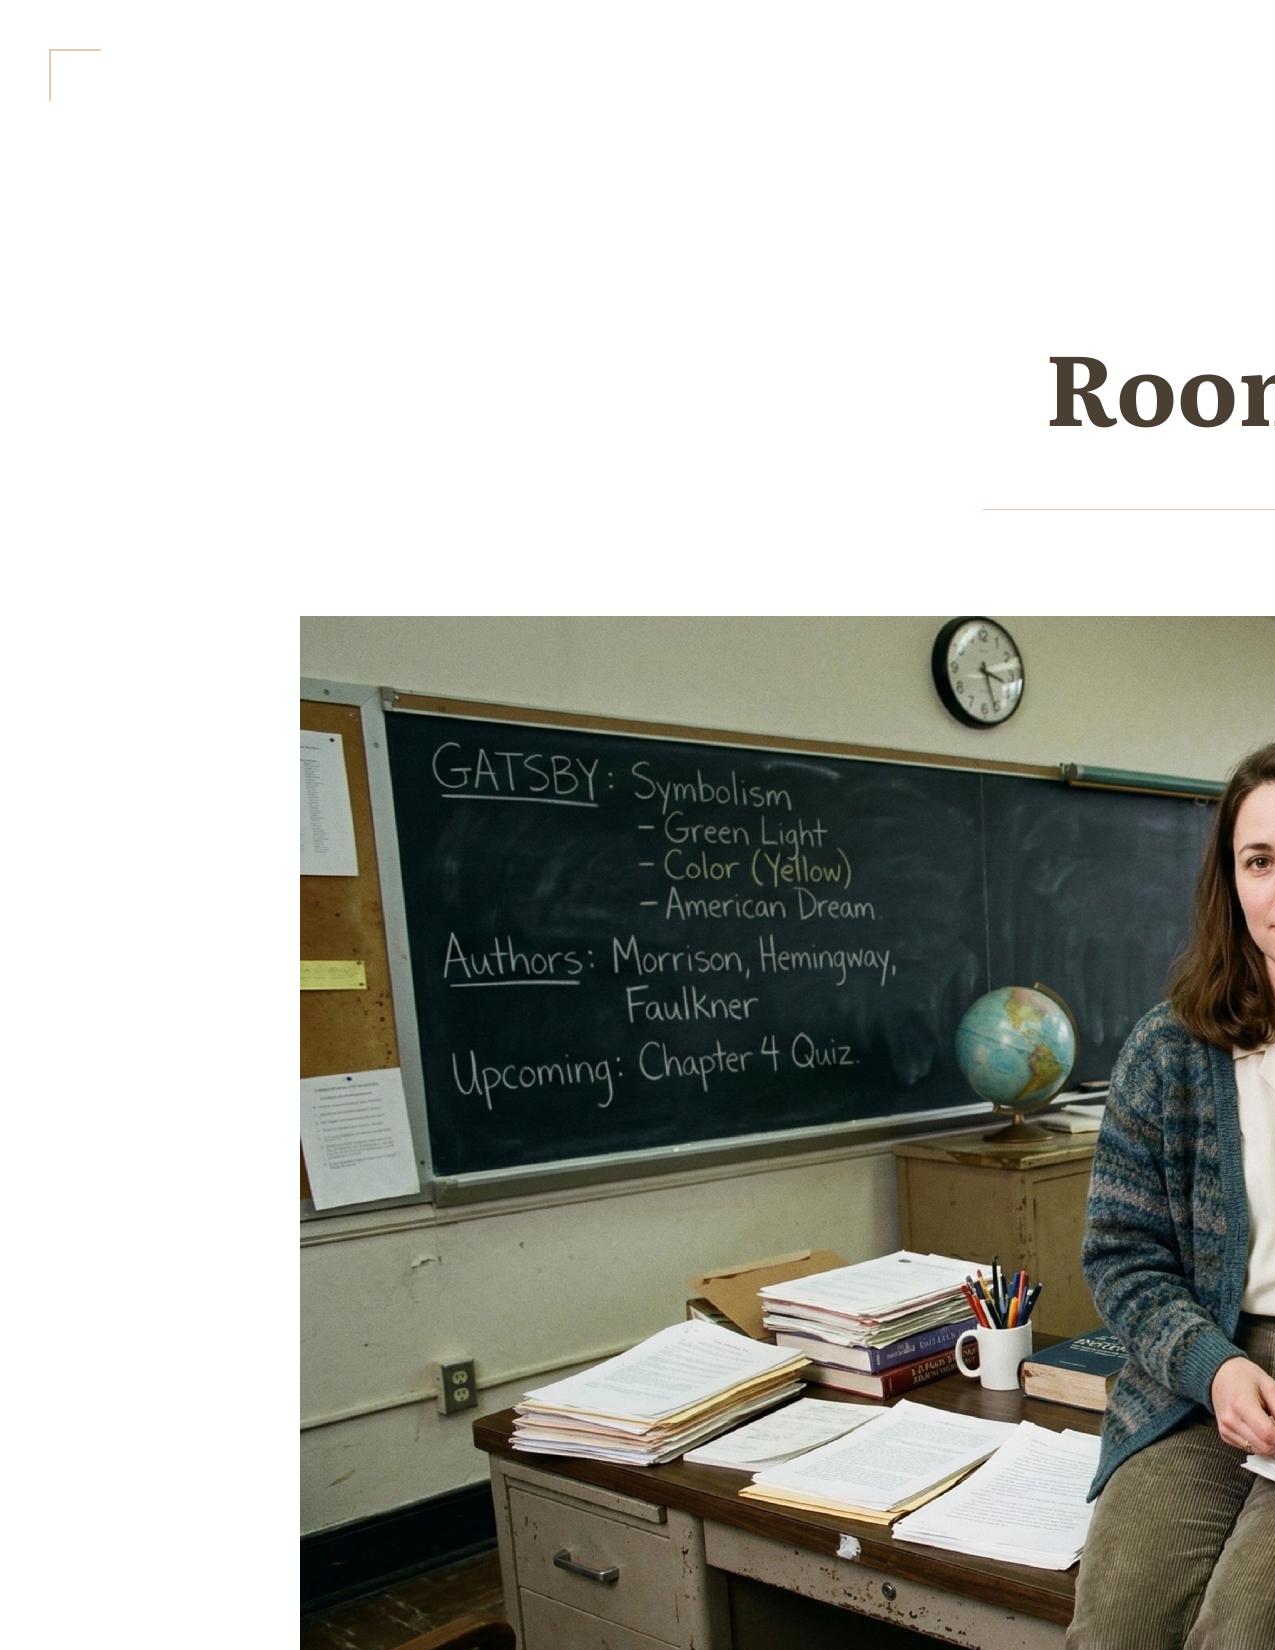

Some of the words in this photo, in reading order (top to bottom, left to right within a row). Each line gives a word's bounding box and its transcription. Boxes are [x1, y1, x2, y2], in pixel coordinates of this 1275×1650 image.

[432, 742, 614, 802] GATSBY:
[631, 761, 792, 815] Symbolism
[664, 811, 750, 846] Green
[761, 815, 829, 860] Light
[664, 849, 741, 880] Color
[752, 848, 852, 889] (Yellow)
[665, 886, 787, 920] American
[793, 887, 876, 920] Dream
[443, 932, 594, 979] Authors:
[613, 934, 750, 980] Morrison,
[758, 933, 896, 987] Hemingway,
[625, 984, 760, 1024] Faulkner
[452, 1049, 624, 1111] Upcoming:
[638, 1039, 754, 1092] Chapter
[760, 1034, 780, 1073] 4
